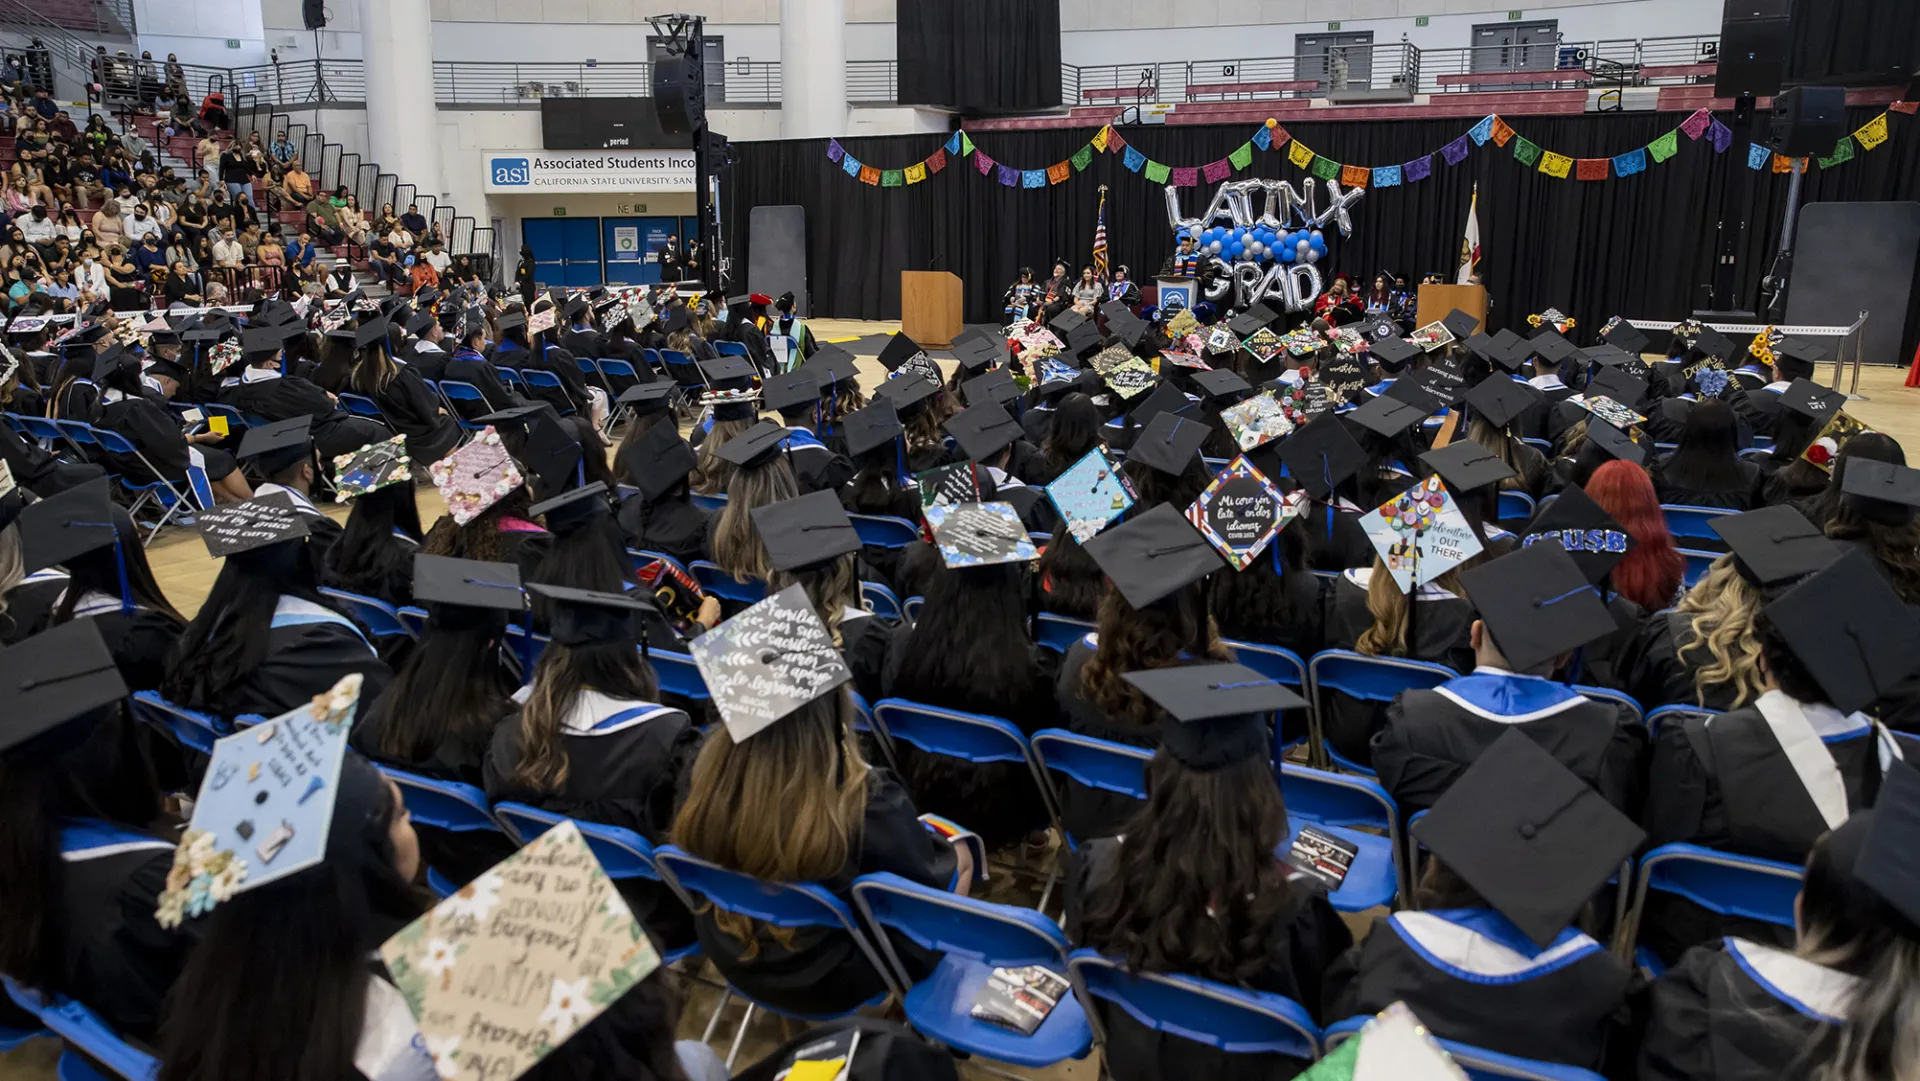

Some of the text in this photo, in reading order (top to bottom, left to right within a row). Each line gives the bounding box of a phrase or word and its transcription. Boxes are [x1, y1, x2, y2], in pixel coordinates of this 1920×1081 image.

[1577, 50, 1586, 60] O
[1705, 44, 1713, 54] P
[137, 66, 147, 76] M
[1142, 69, 1152, 79] N
[1225, 67, 1233, 75] O
[534, 157, 696, 169] Associated Students Inco
[496, 161, 530, 183] asi
[534, 177, 589, 186] CALIFORNIA
[591, 177, 617, 185] STATE
[673, 176, 692, 184] SAN
[618, 204, 629, 214] NE
[1165, 177, 1365, 236] LATINX
[1205, 257, 1322, 313] GRAD
[1673, 326, 1701, 337] HOGWA
[1445, 359, 1456, 368] The
[1427, 366, 1463, 383] starting point
[1218, 495, 1234, 506] Mi
[1217, 507, 1234, 519] late
[1256, 505, 1271, 519] dos
[200, 514, 233, 523] and
[230, 516, 248, 526] by
[1226, 519, 1262, 532] idiomas
[206, 524, 277, 540] I will carry
[1431, 520, 1472, 540] Adventure
[1439, 536, 1460, 547] OUT
[1431, 545, 1463, 561] THERE
[762, 621, 824, 640] por sus
[769, 664, 833, 687] y apoyo
[554, 874, 581, 893] on
[490, 914, 580, 959] teaching
